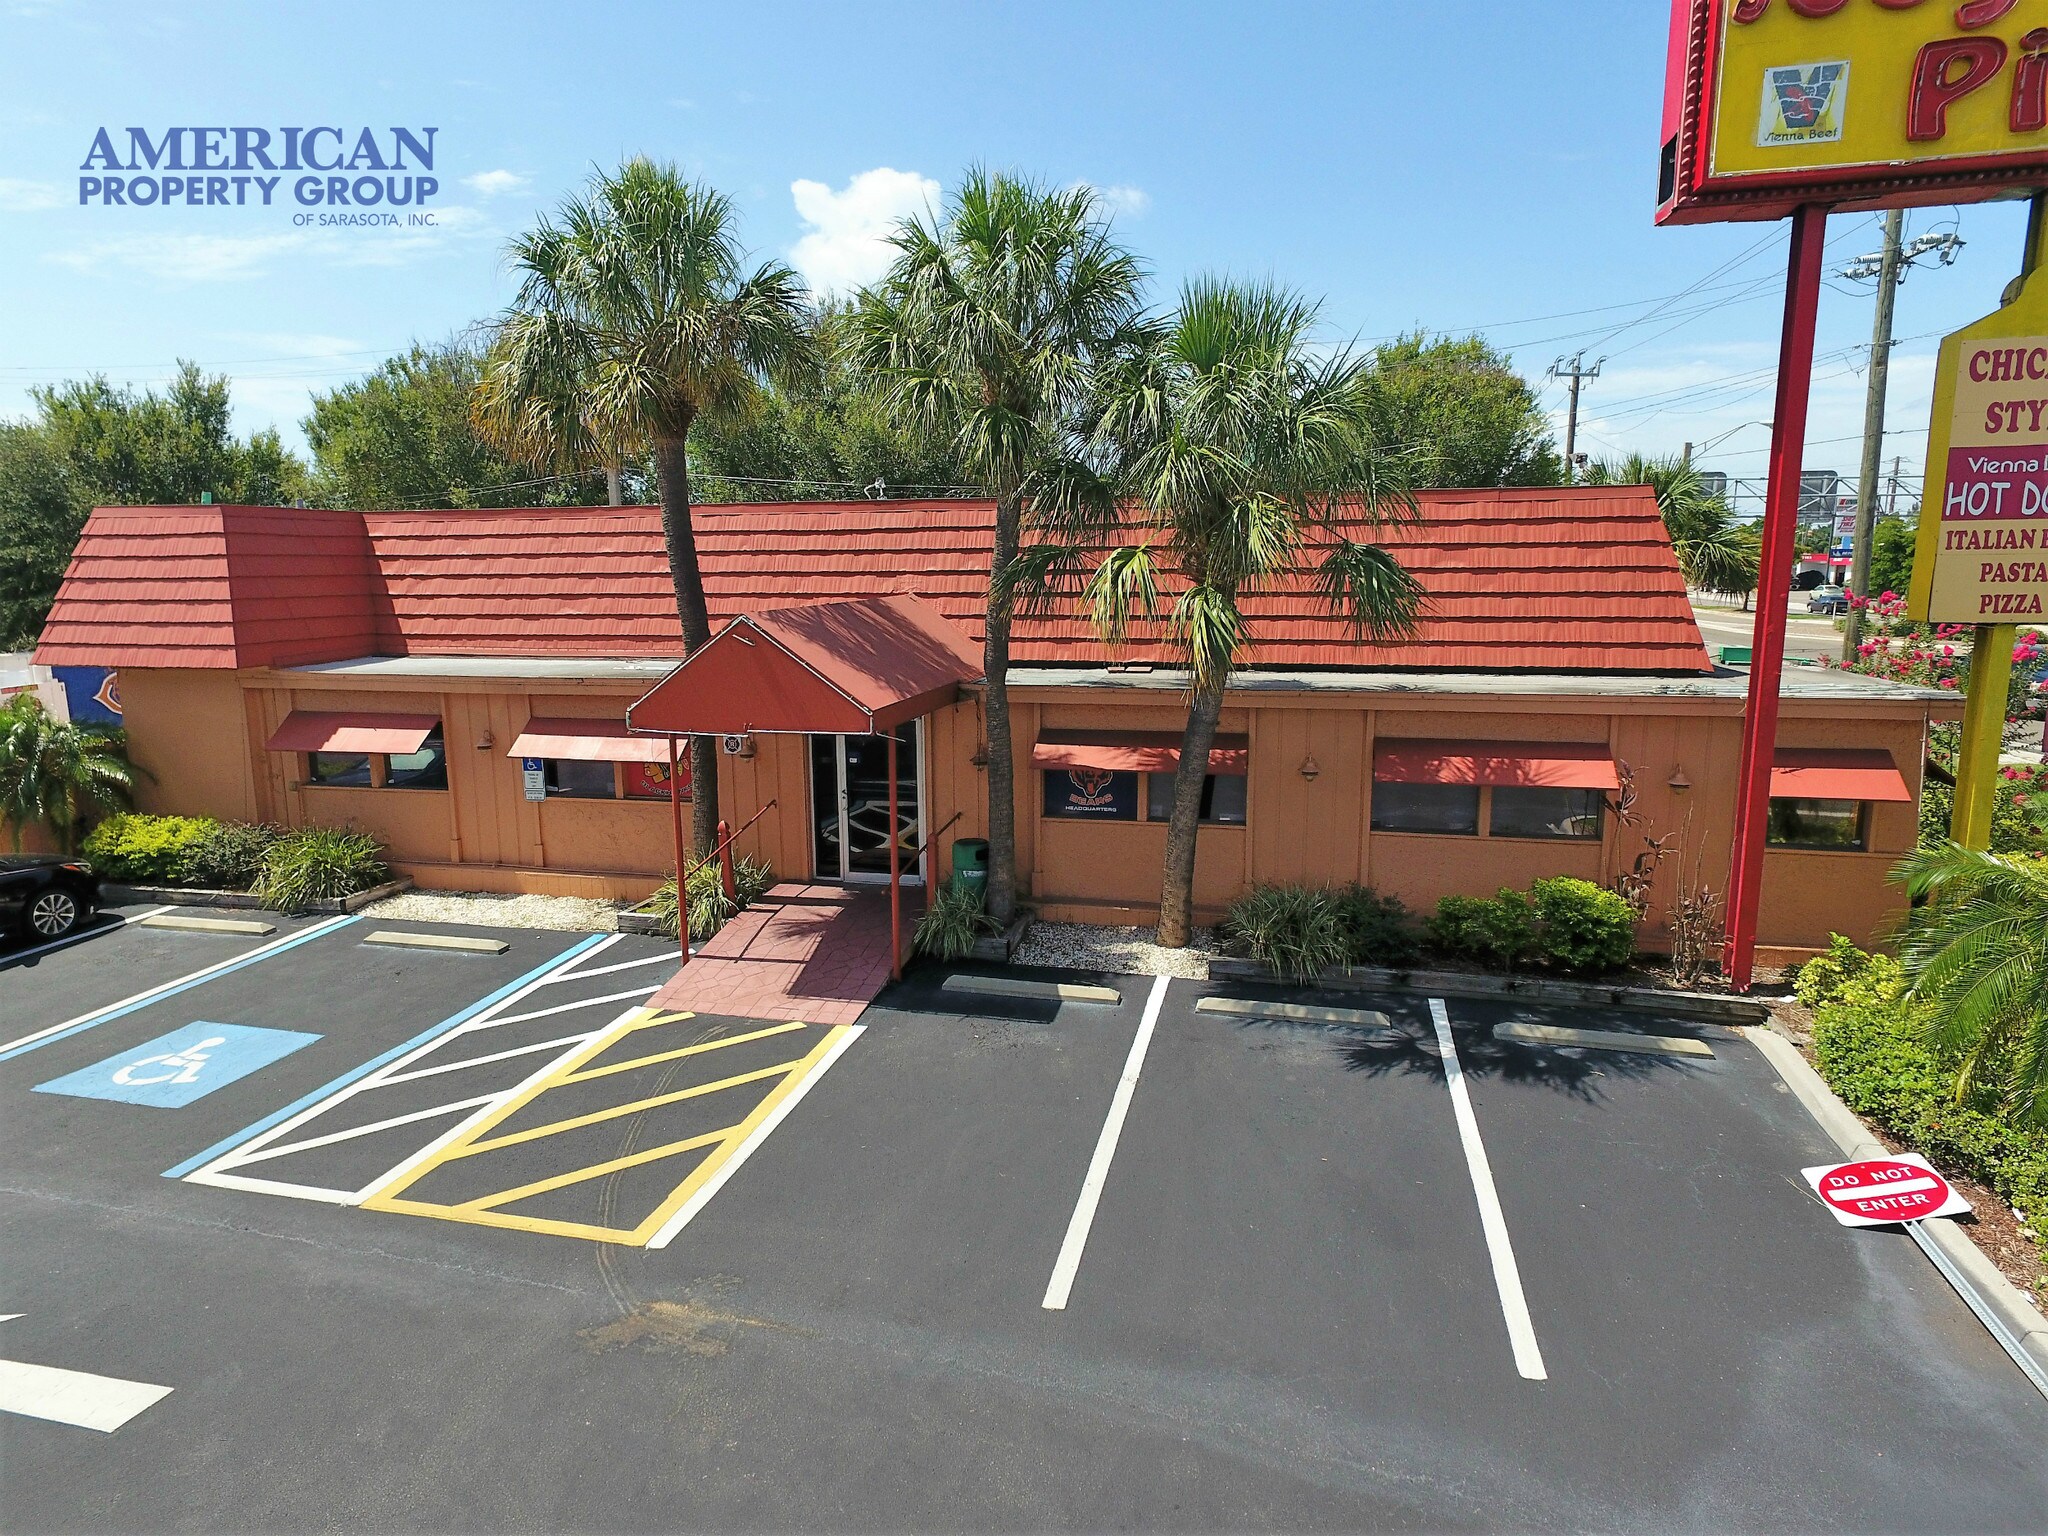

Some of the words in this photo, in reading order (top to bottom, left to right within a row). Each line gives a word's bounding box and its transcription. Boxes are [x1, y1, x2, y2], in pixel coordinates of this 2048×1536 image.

[1809, 127, 1838, 139] Beef
[1969, 347, 2048, 382] CHIC
[1985, 399, 2048, 433] STY
[1968, 455, 2039, 474] Vienna
[1945, 481, 2011, 516] HOT
[1945, 529, 2037, 550] ITALIAN
[1979, 562, 2048, 583] PASTA
[1979, 594, 2042, 614] PIZZA
[1069, 793, 1113, 806] BEARS
[1829, 1175, 1860, 1187] DO
[1871, 1166, 1913, 1182] NOT
[1857, 1193, 1930, 1213] ENTER
